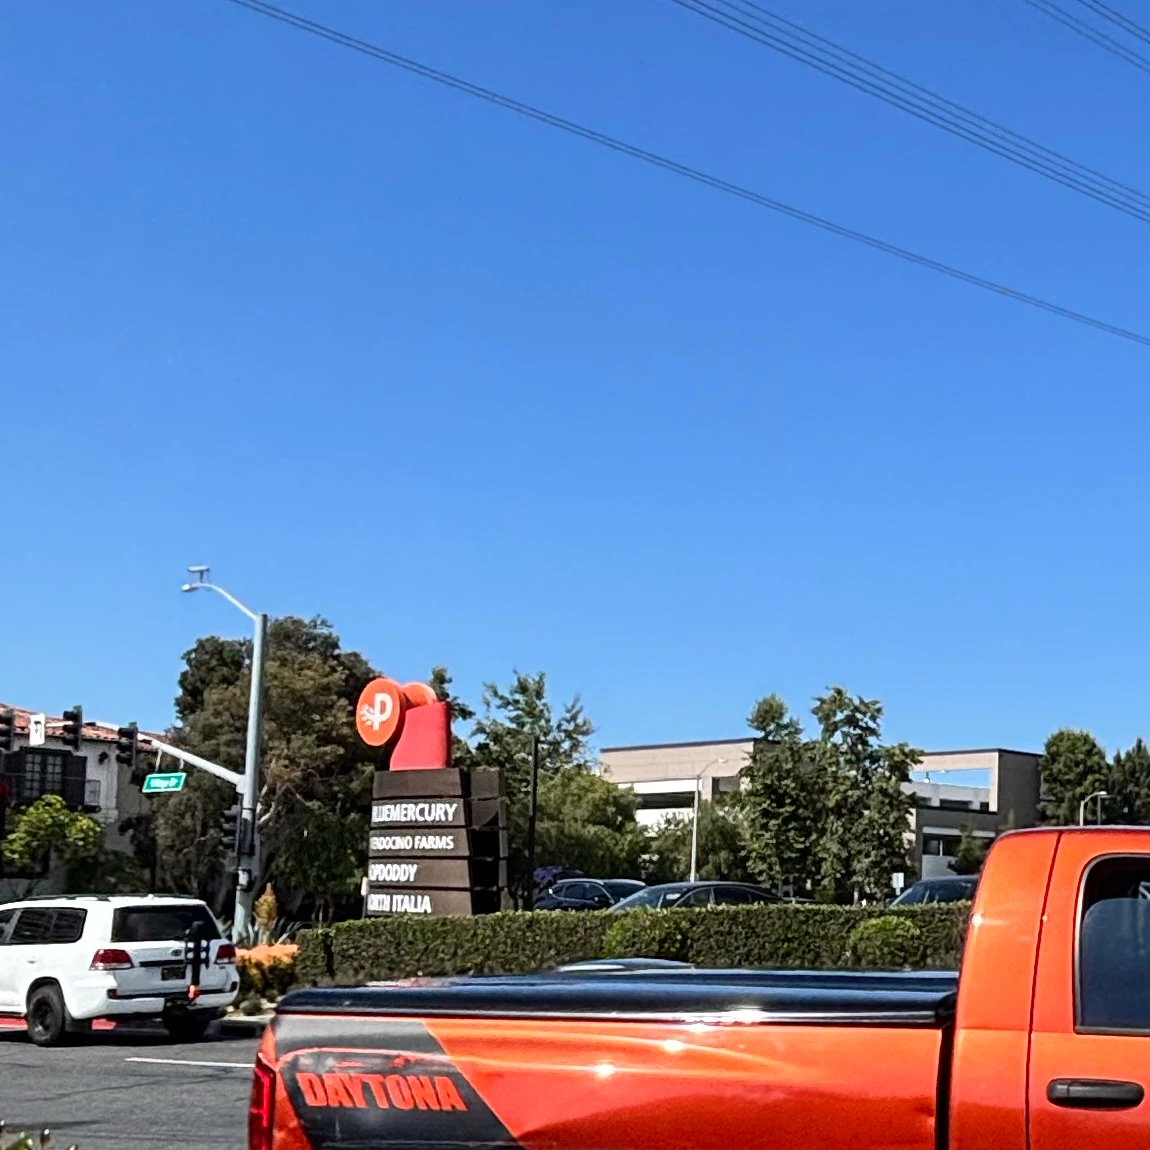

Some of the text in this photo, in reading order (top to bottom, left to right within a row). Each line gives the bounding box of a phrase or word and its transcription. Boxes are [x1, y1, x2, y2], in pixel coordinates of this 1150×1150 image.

[414, 835, 454, 850] FARMS
[392, 895, 432, 913] ITALIA
[296, 1072, 468, 1111] DAYTONA
